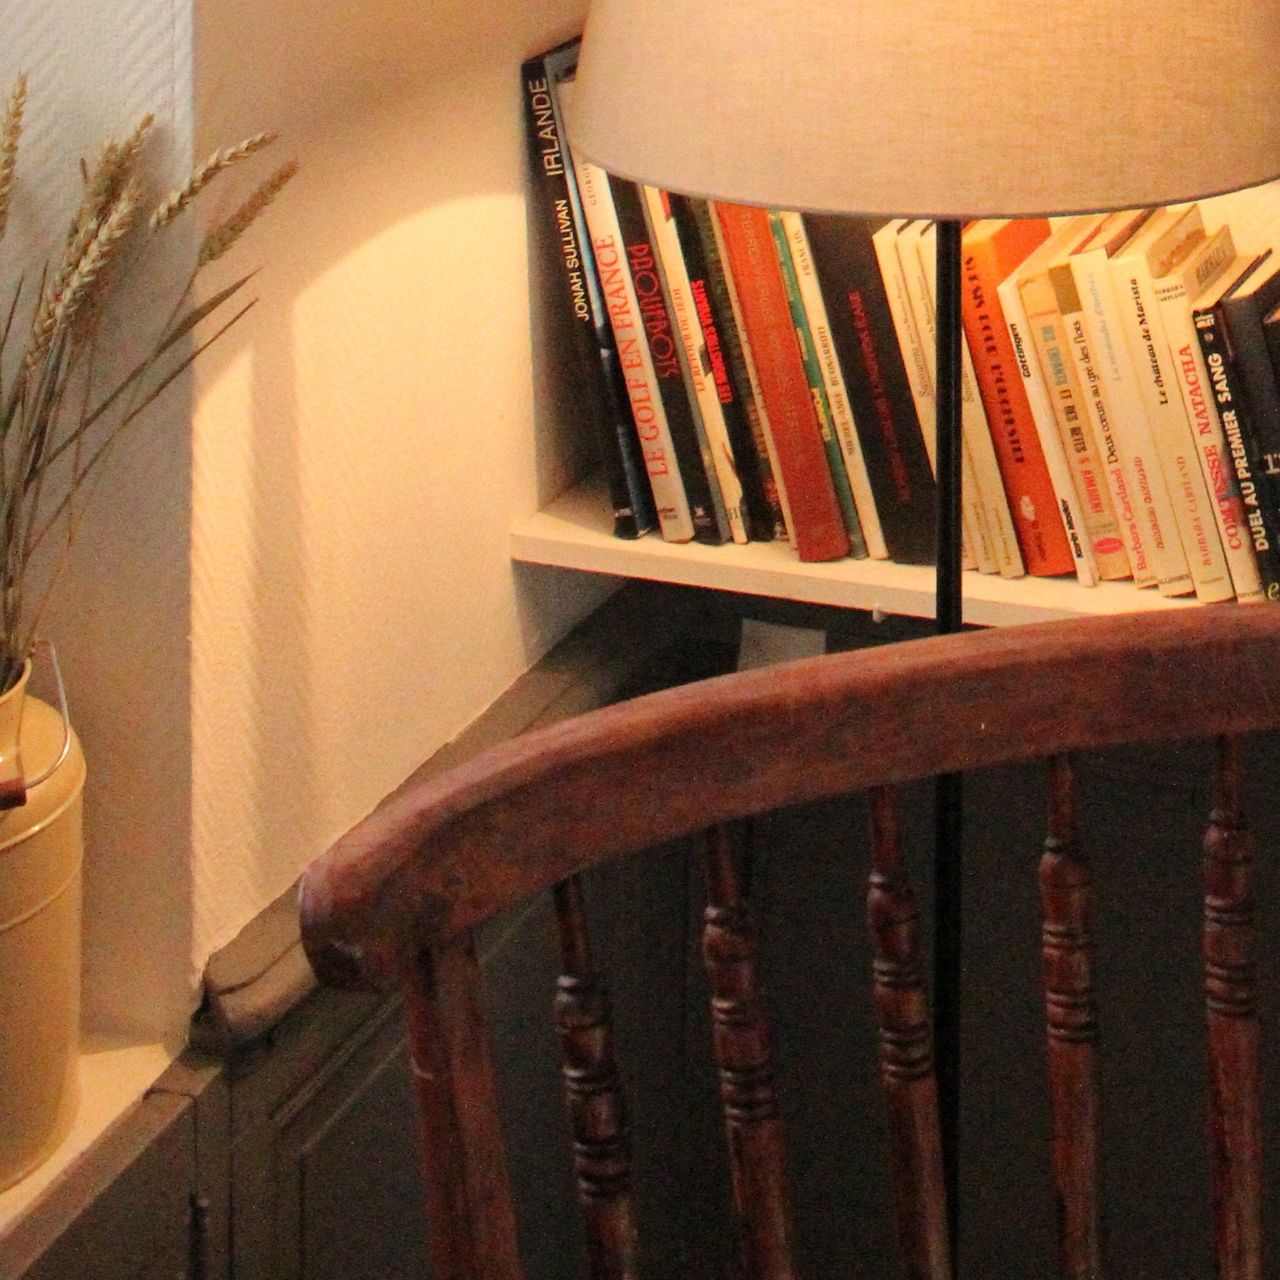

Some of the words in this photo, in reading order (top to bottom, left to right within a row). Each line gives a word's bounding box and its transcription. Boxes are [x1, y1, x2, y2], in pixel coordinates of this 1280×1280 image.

[529, 77, 564, 176] IRLANDE
[555, 199, 580, 267] SULLIVAN
[569, 272, 590, 321] JONAH
[594, 235, 633, 330] FRANCE
[673, 288, 685, 313] JEDI
[691, 281, 713, 325] VIVANTS
[1130, 278, 1148, 325] Marista
[679, 316, 689, 330] DU
[1072, 320, 1087, 343] flots
[1141, 328, 1153, 341] de
[619, 338, 642, 369] EN
[682, 333, 700, 376] RETOUR
[817, 326, 840, 386] BUONARROTI
[1077, 346, 1093, 363] des
[1090, 384, 1101, 397] au
[1158, 390, 1169, 405] Le
[1180, 344, 1211, 436] NATACHA
[1208, 353, 1231, 403] SANG
[625, 379, 660, 440] GOLF
[833, 392, 855, 455] MICHEL-ANGE
[647, 448, 669, 477] LE
[1101, 435, 1119, 465] Deux
[1223, 409, 1251, 480] PREMIER
[1111, 469, 1133, 521] Cartland
[1176, 456, 1199, 512] CARTLAND
[1204, 444, 1241, 549] COMTESSE
[1240, 483, 1259, 507] AU
[1126, 524, 1147, 572] Barbara
[1193, 516, 1212, 566] BARBARA
[1249, 509, 1270, 551] DUEL
